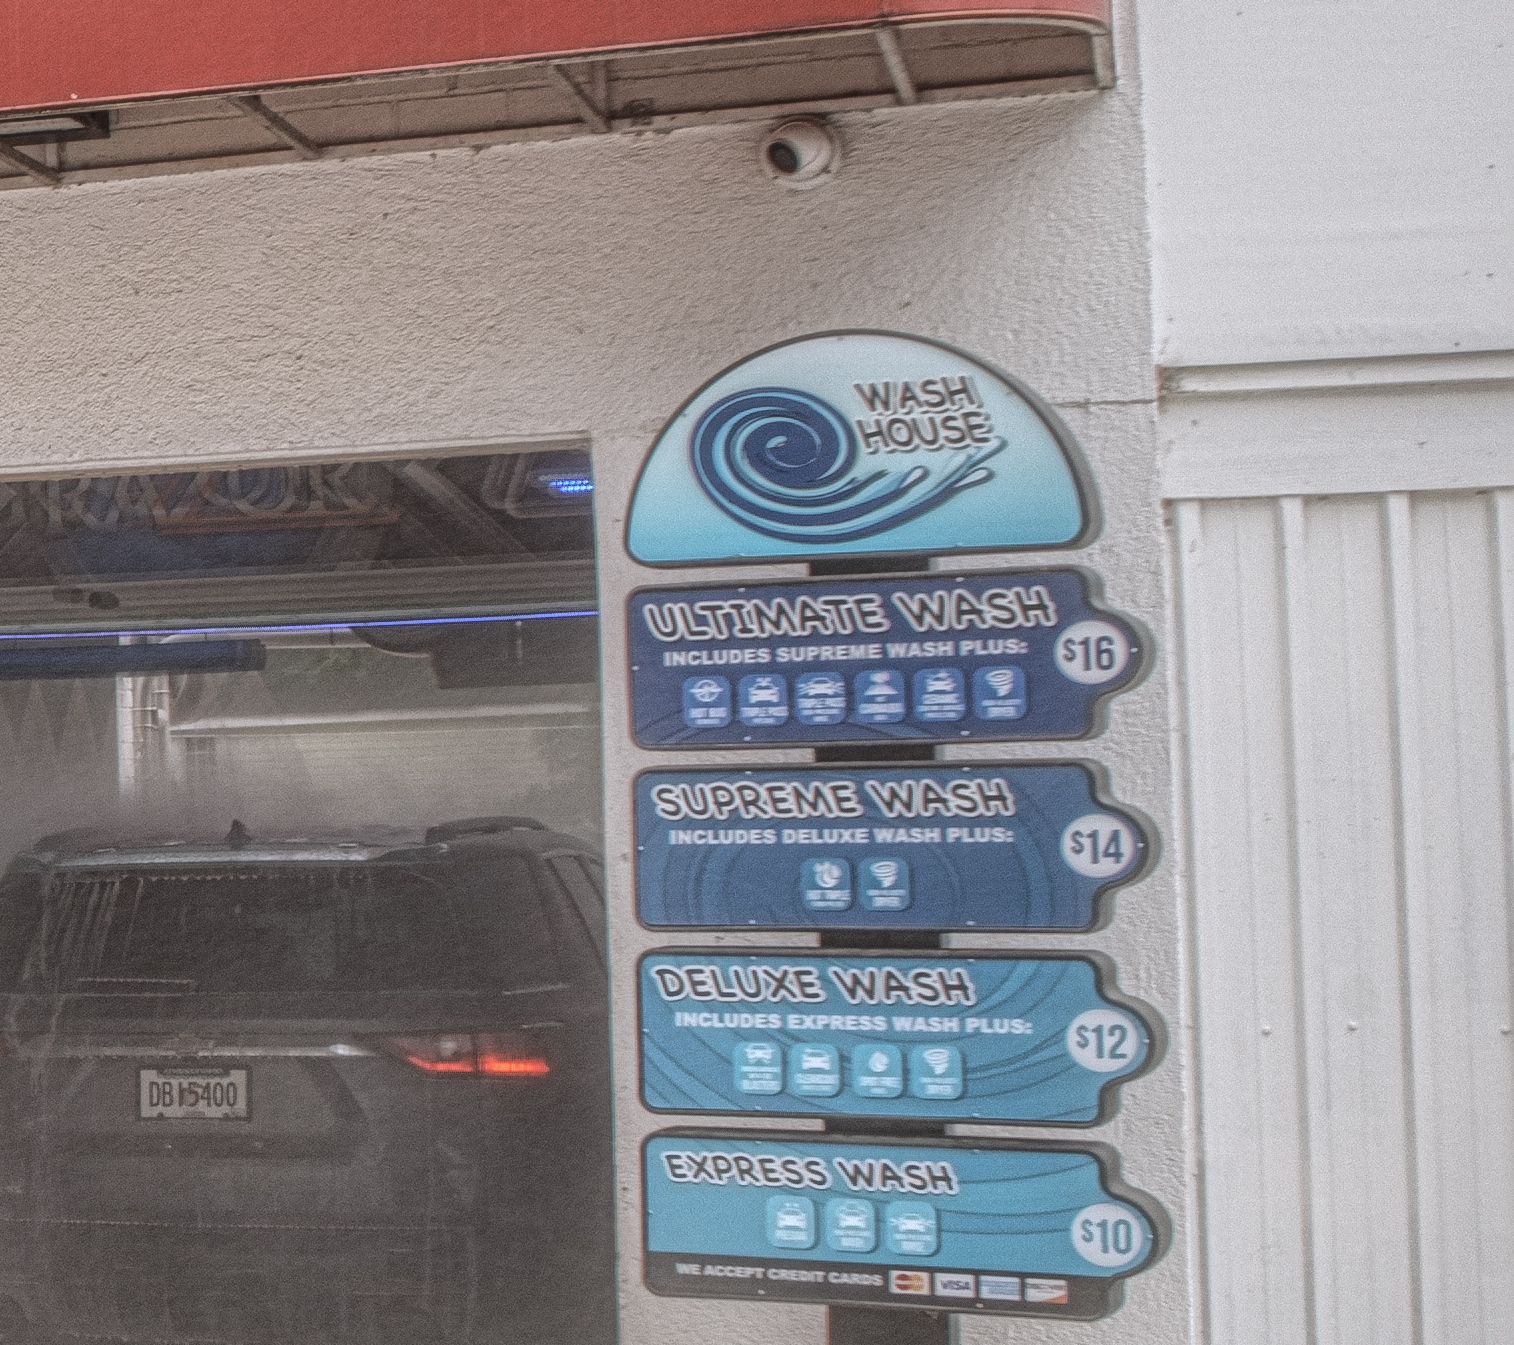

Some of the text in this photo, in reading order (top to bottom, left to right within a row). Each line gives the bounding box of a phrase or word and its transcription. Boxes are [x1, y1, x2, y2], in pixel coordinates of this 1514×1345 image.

[853, 375, 979, 413] WASH
[855, 410, 992, 450] HOUSE
[643, 584, 1058, 642] ULTIMATE WASH
[663, 637, 1029, 667] INCLUDES SUPREME WASH PLUS:
[1061, 634, 1116, 672] $16
[651, 778, 1016, 821] SUPREME WASH
[669, 826, 1015, 845] INCLUDES DELUXE WASH PLUS:
[1069, 828, 1126, 865] $14
[652, 964, 977, 1006] DELUXE WASH
[674, 1011, 1035, 1035] INCLUDES EXPRESS WASH PLUS:
[1075, 1023, 1129, 1060] $12
[661, 1151, 960, 1196] EXPRESS WASH
[1080, 1218, 1133, 1255] $10
[675, 1262, 884, 1287] WE ACCEPT CREDIT CARDS
